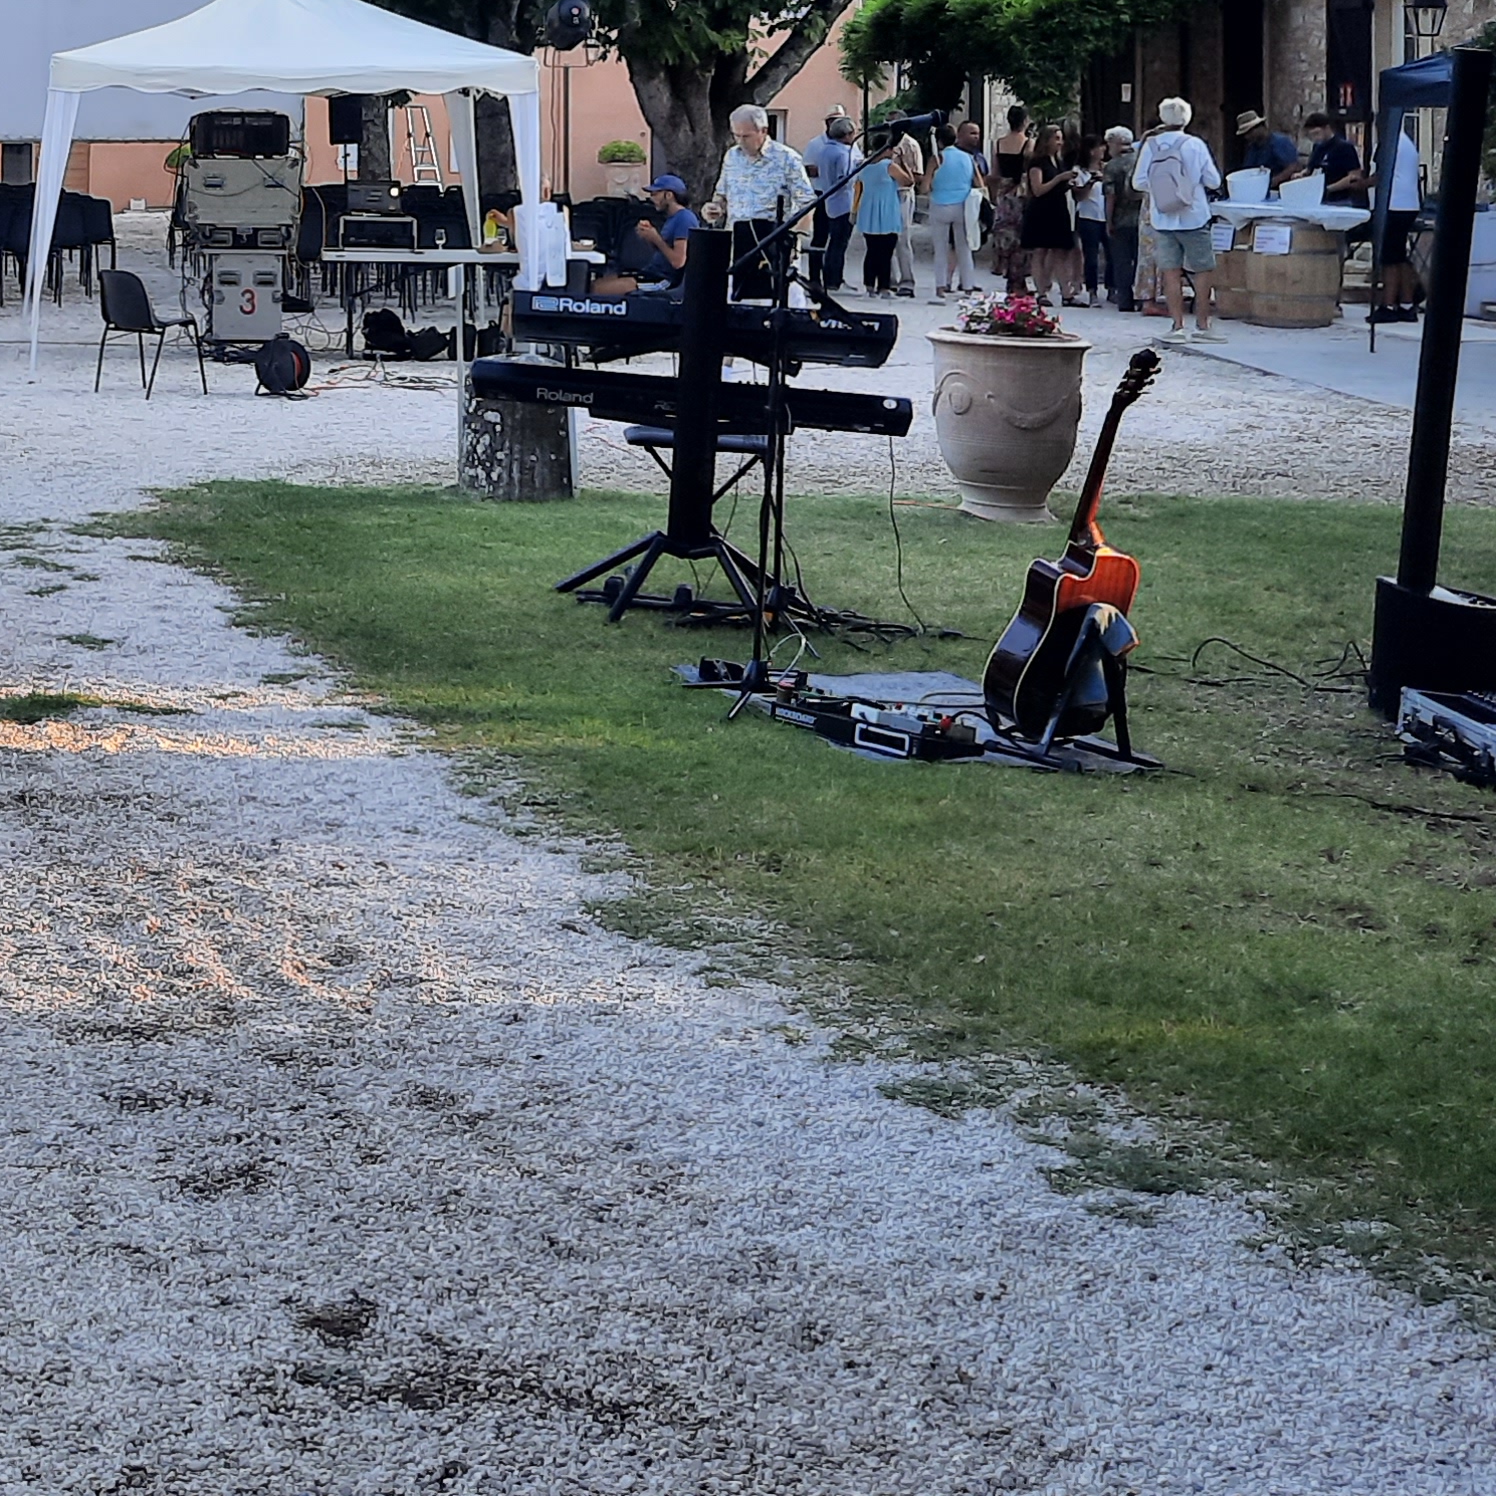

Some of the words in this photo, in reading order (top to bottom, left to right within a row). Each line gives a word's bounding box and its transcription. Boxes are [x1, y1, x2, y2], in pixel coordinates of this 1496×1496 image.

[239, 288, 256, 315] 3
[559, 298, 627, 315] Roland
[536, 387, 594, 404] Roland
